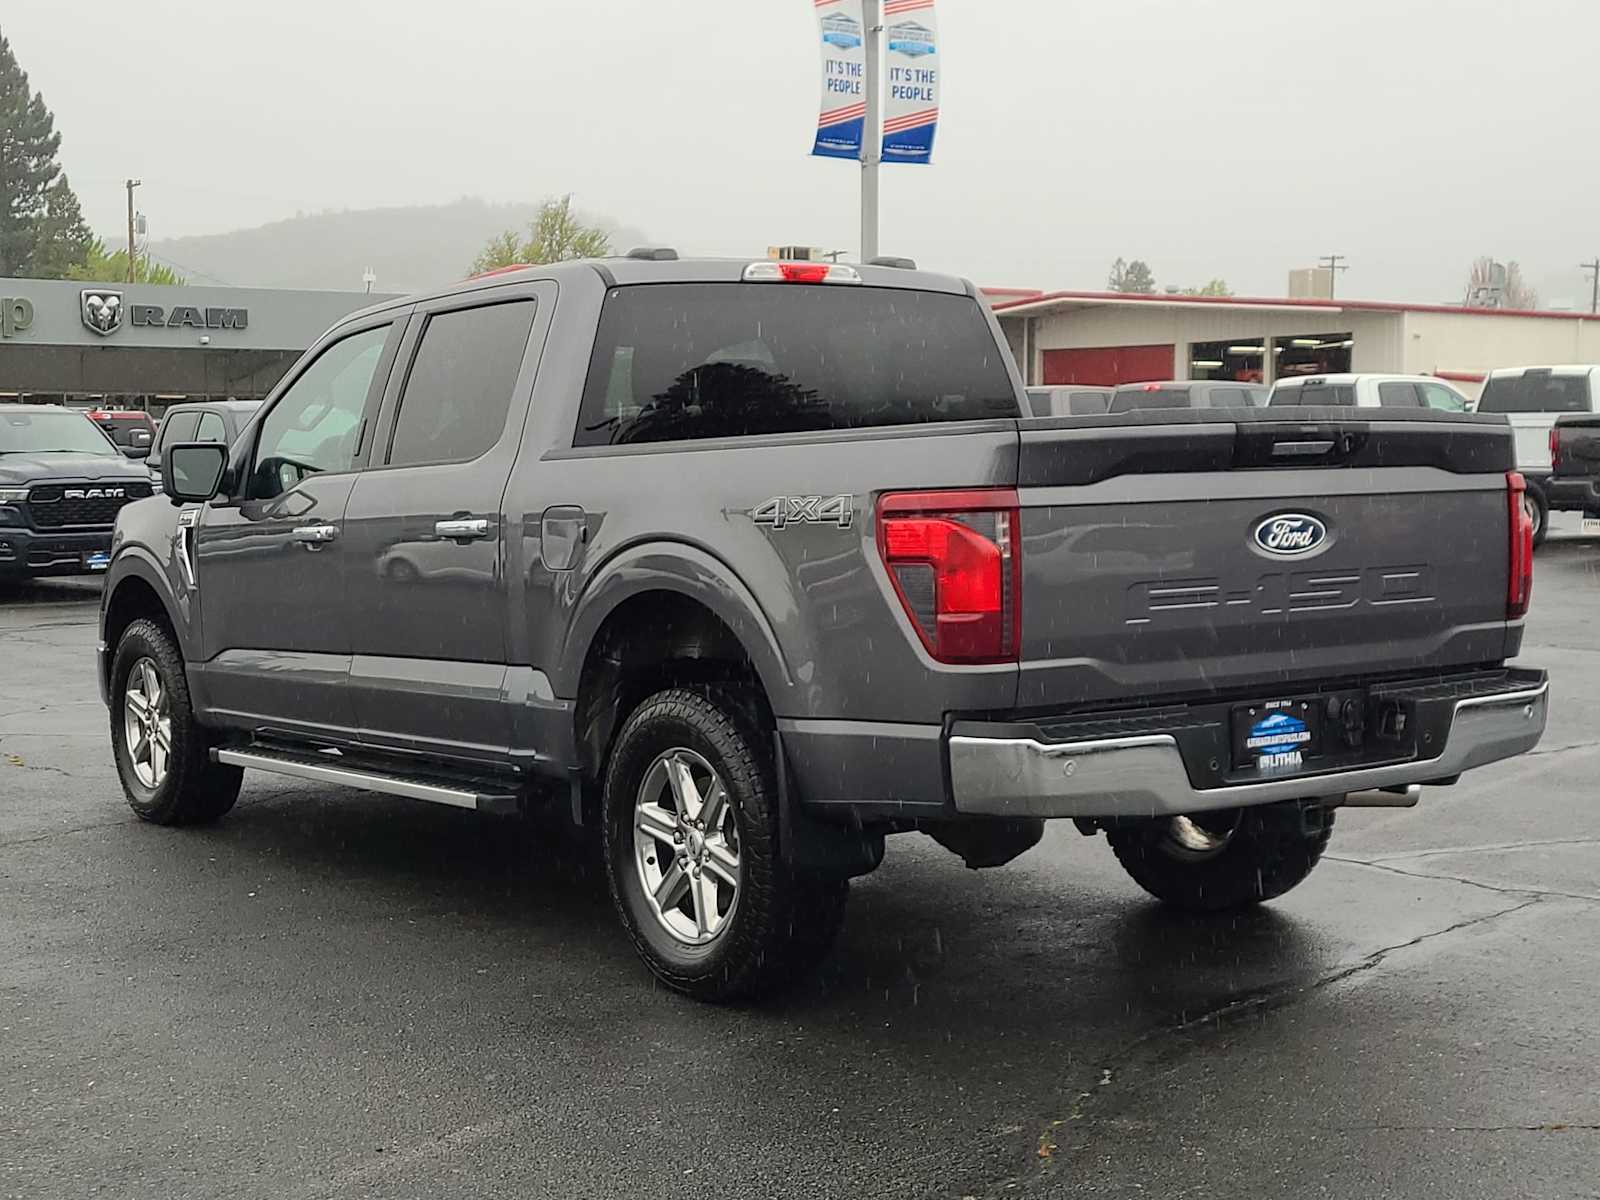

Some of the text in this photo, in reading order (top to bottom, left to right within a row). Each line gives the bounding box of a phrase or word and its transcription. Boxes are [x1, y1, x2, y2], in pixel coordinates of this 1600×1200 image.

[826, 60, 863, 77] IT'S THE
[890, 67, 935, 84] IT'S THE
[827, 78, 861, 95] PEOPLE
[892, 85, 934, 101] PEOPLE
[131, 304, 248, 329] RAM
[64, 488, 125, 499] RAM
[1267, 520, 1314, 547] Ford
[1126, 564, 1436, 625] F-150
